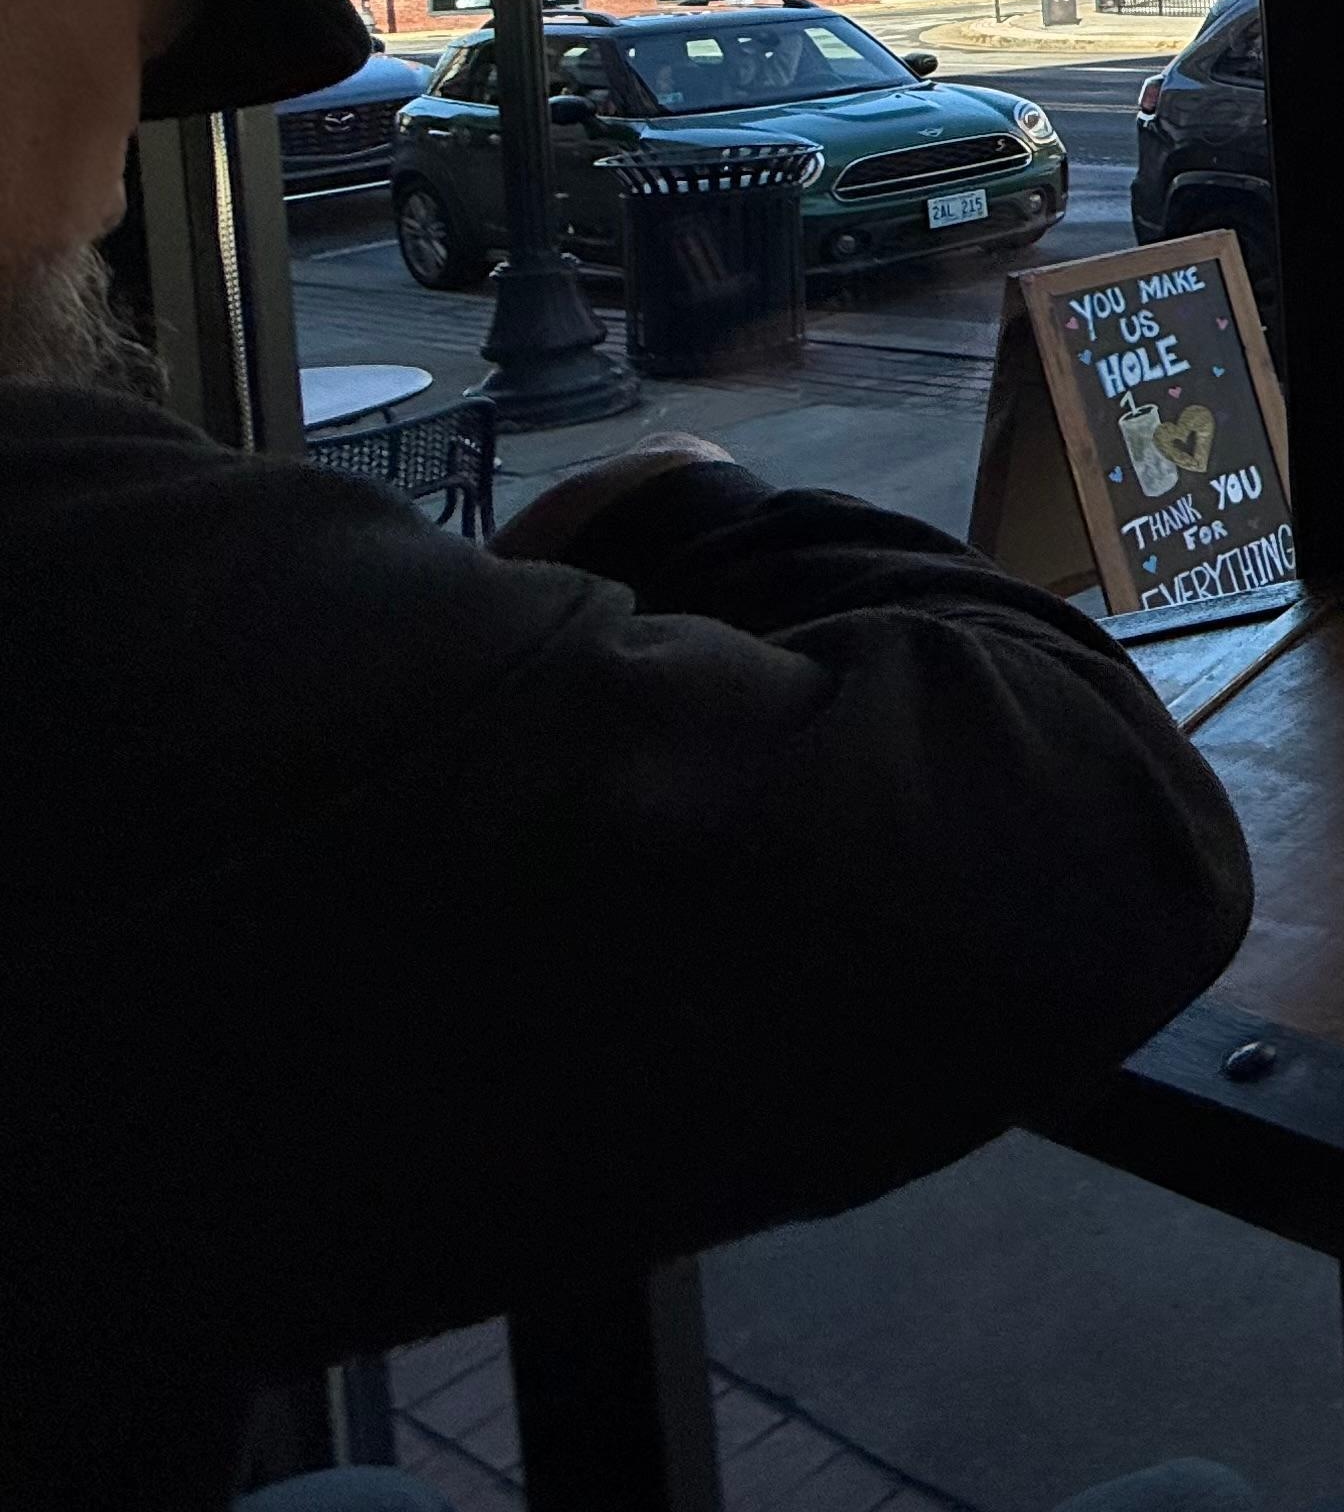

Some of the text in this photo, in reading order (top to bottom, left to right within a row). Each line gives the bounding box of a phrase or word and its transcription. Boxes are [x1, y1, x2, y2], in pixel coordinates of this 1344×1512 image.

[961, 197, 983, 214] 215
[1069, 265, 1206, 342] YOU MAKE
[1121, 309, 1160, 343] US
[1096, 335, 1190, 399] HOLE
[1121, 465, 1263, 551] THANK YOU
[1183, 519, 1228, 552] FOR
[1139, 524, 1296, 611] EVERYTHING
